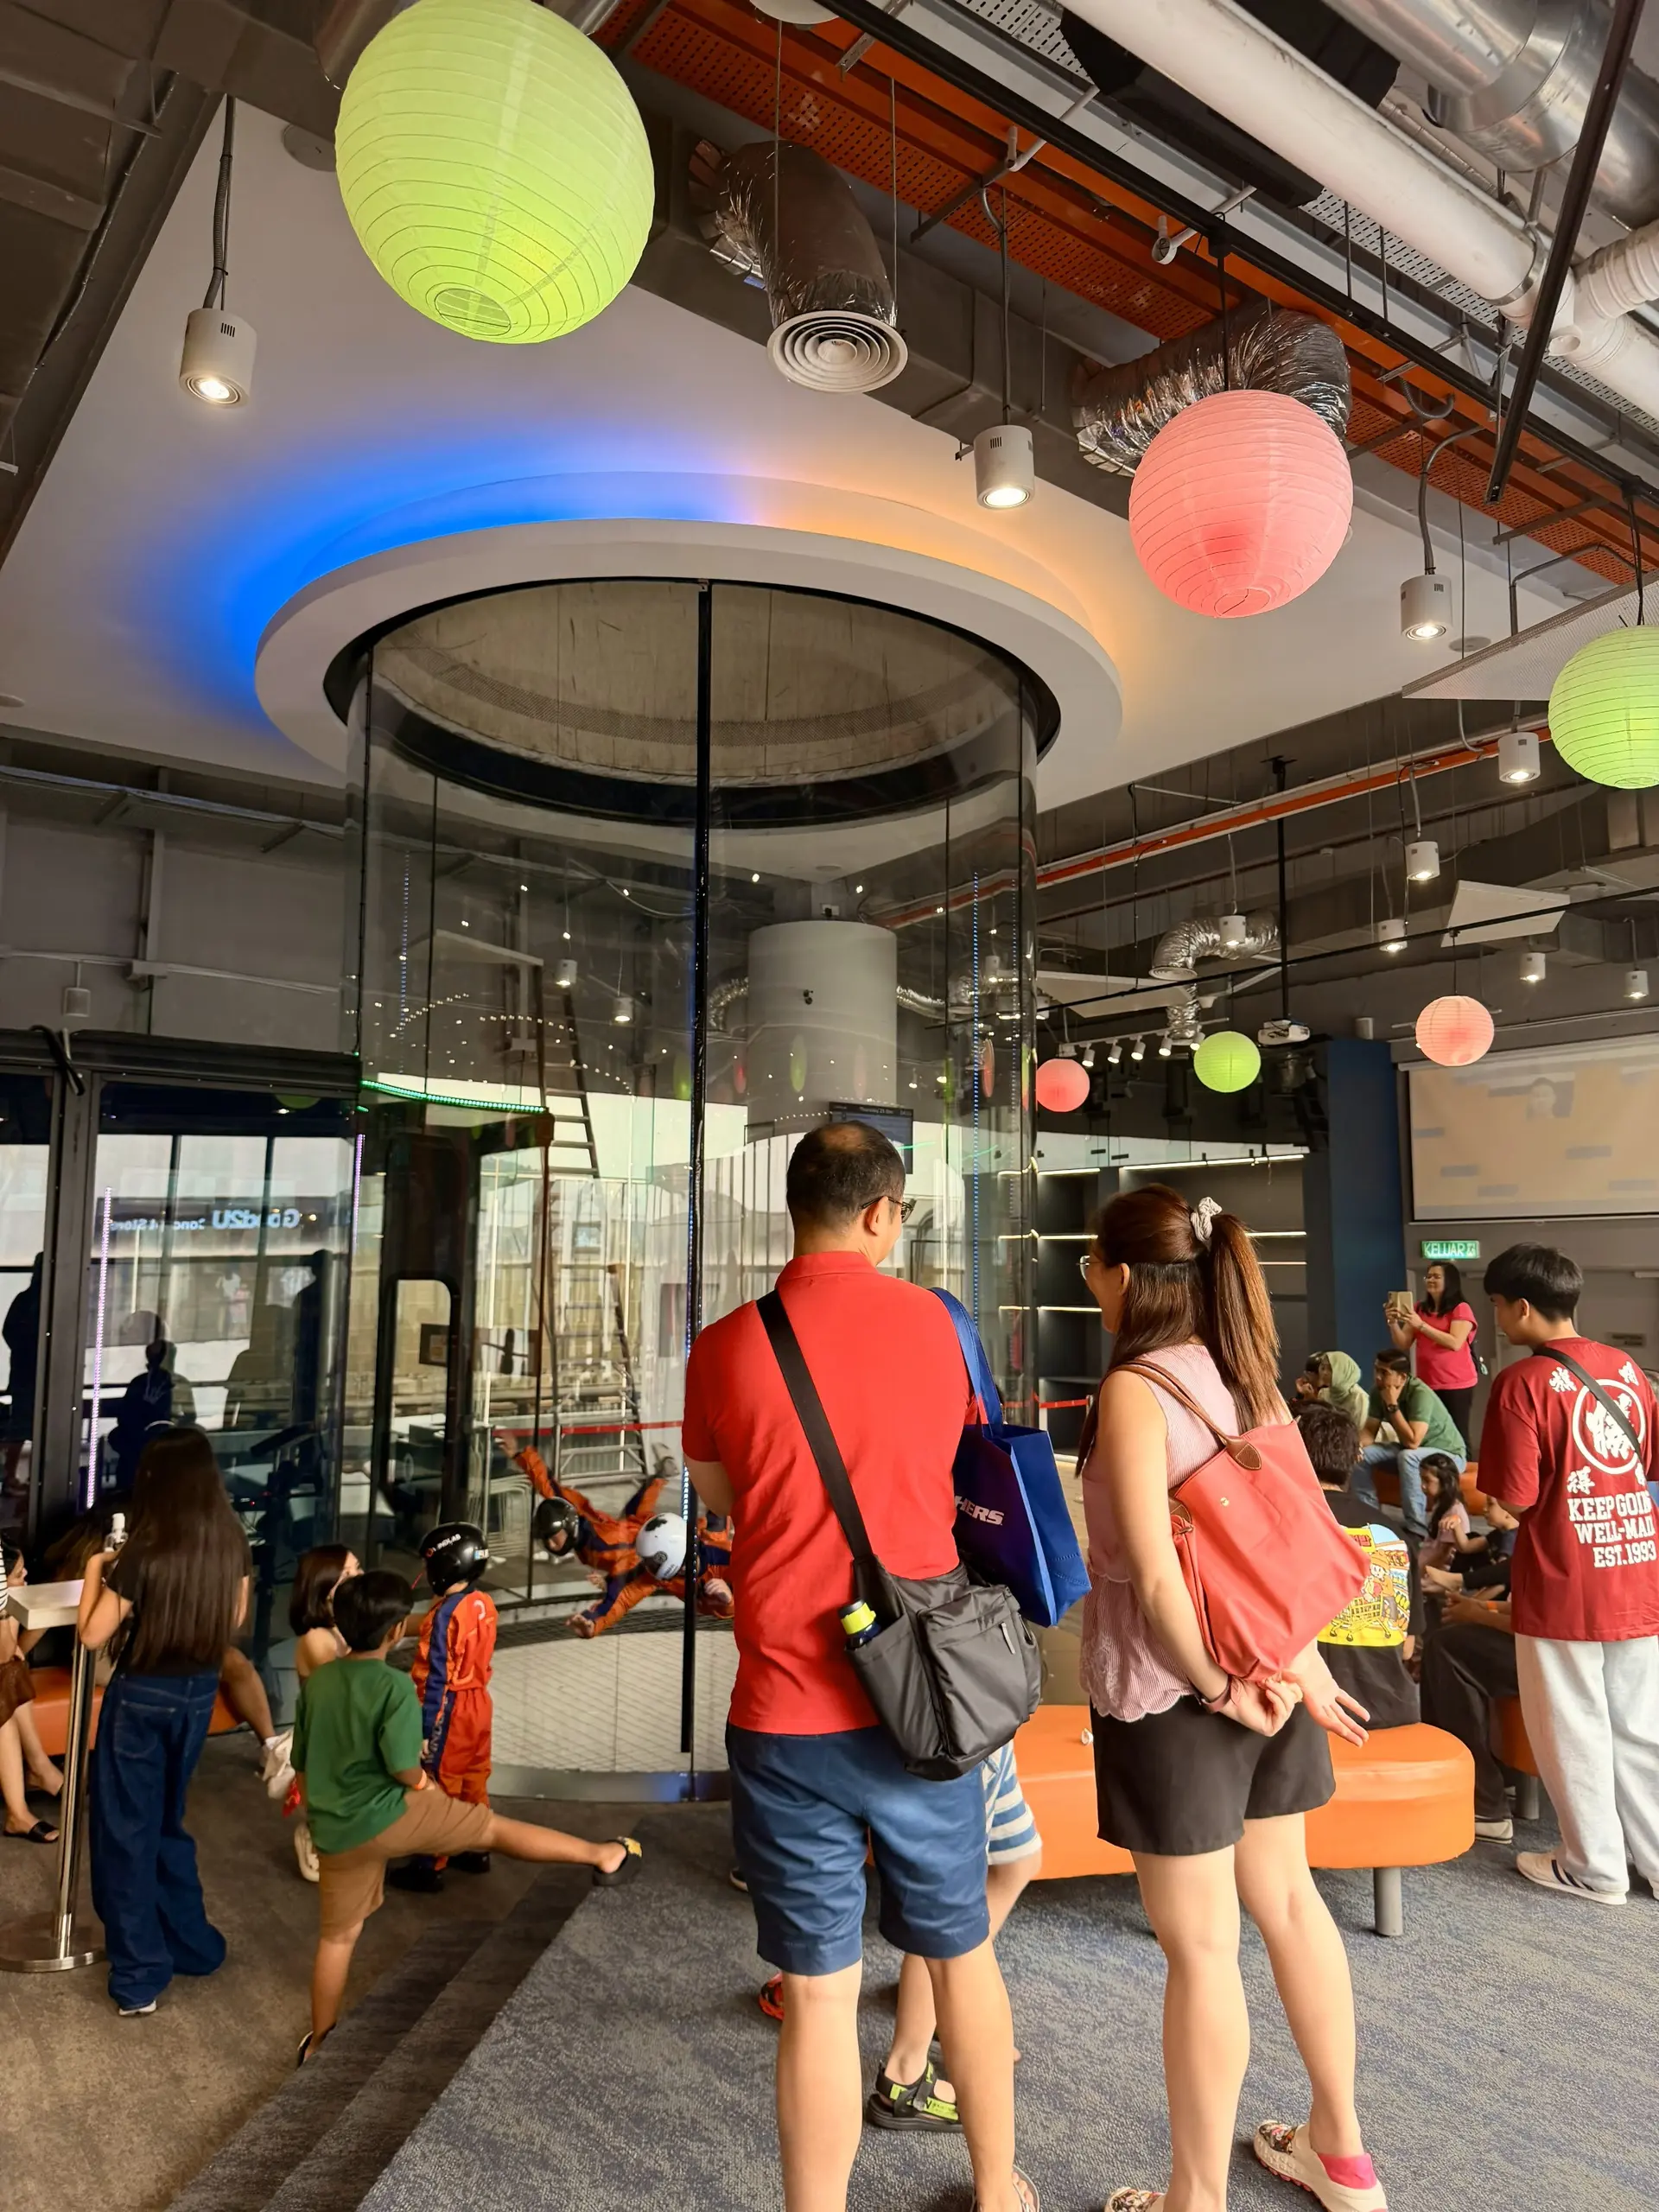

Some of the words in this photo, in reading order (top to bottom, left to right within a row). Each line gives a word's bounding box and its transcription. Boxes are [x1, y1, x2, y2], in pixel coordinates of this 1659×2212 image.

[1424, 1243, 1465, 1257] KELUAR
[1567, 1496, 1615, 1522] KEEP
[1592, 1540, 1657, 1568] EST.1993
